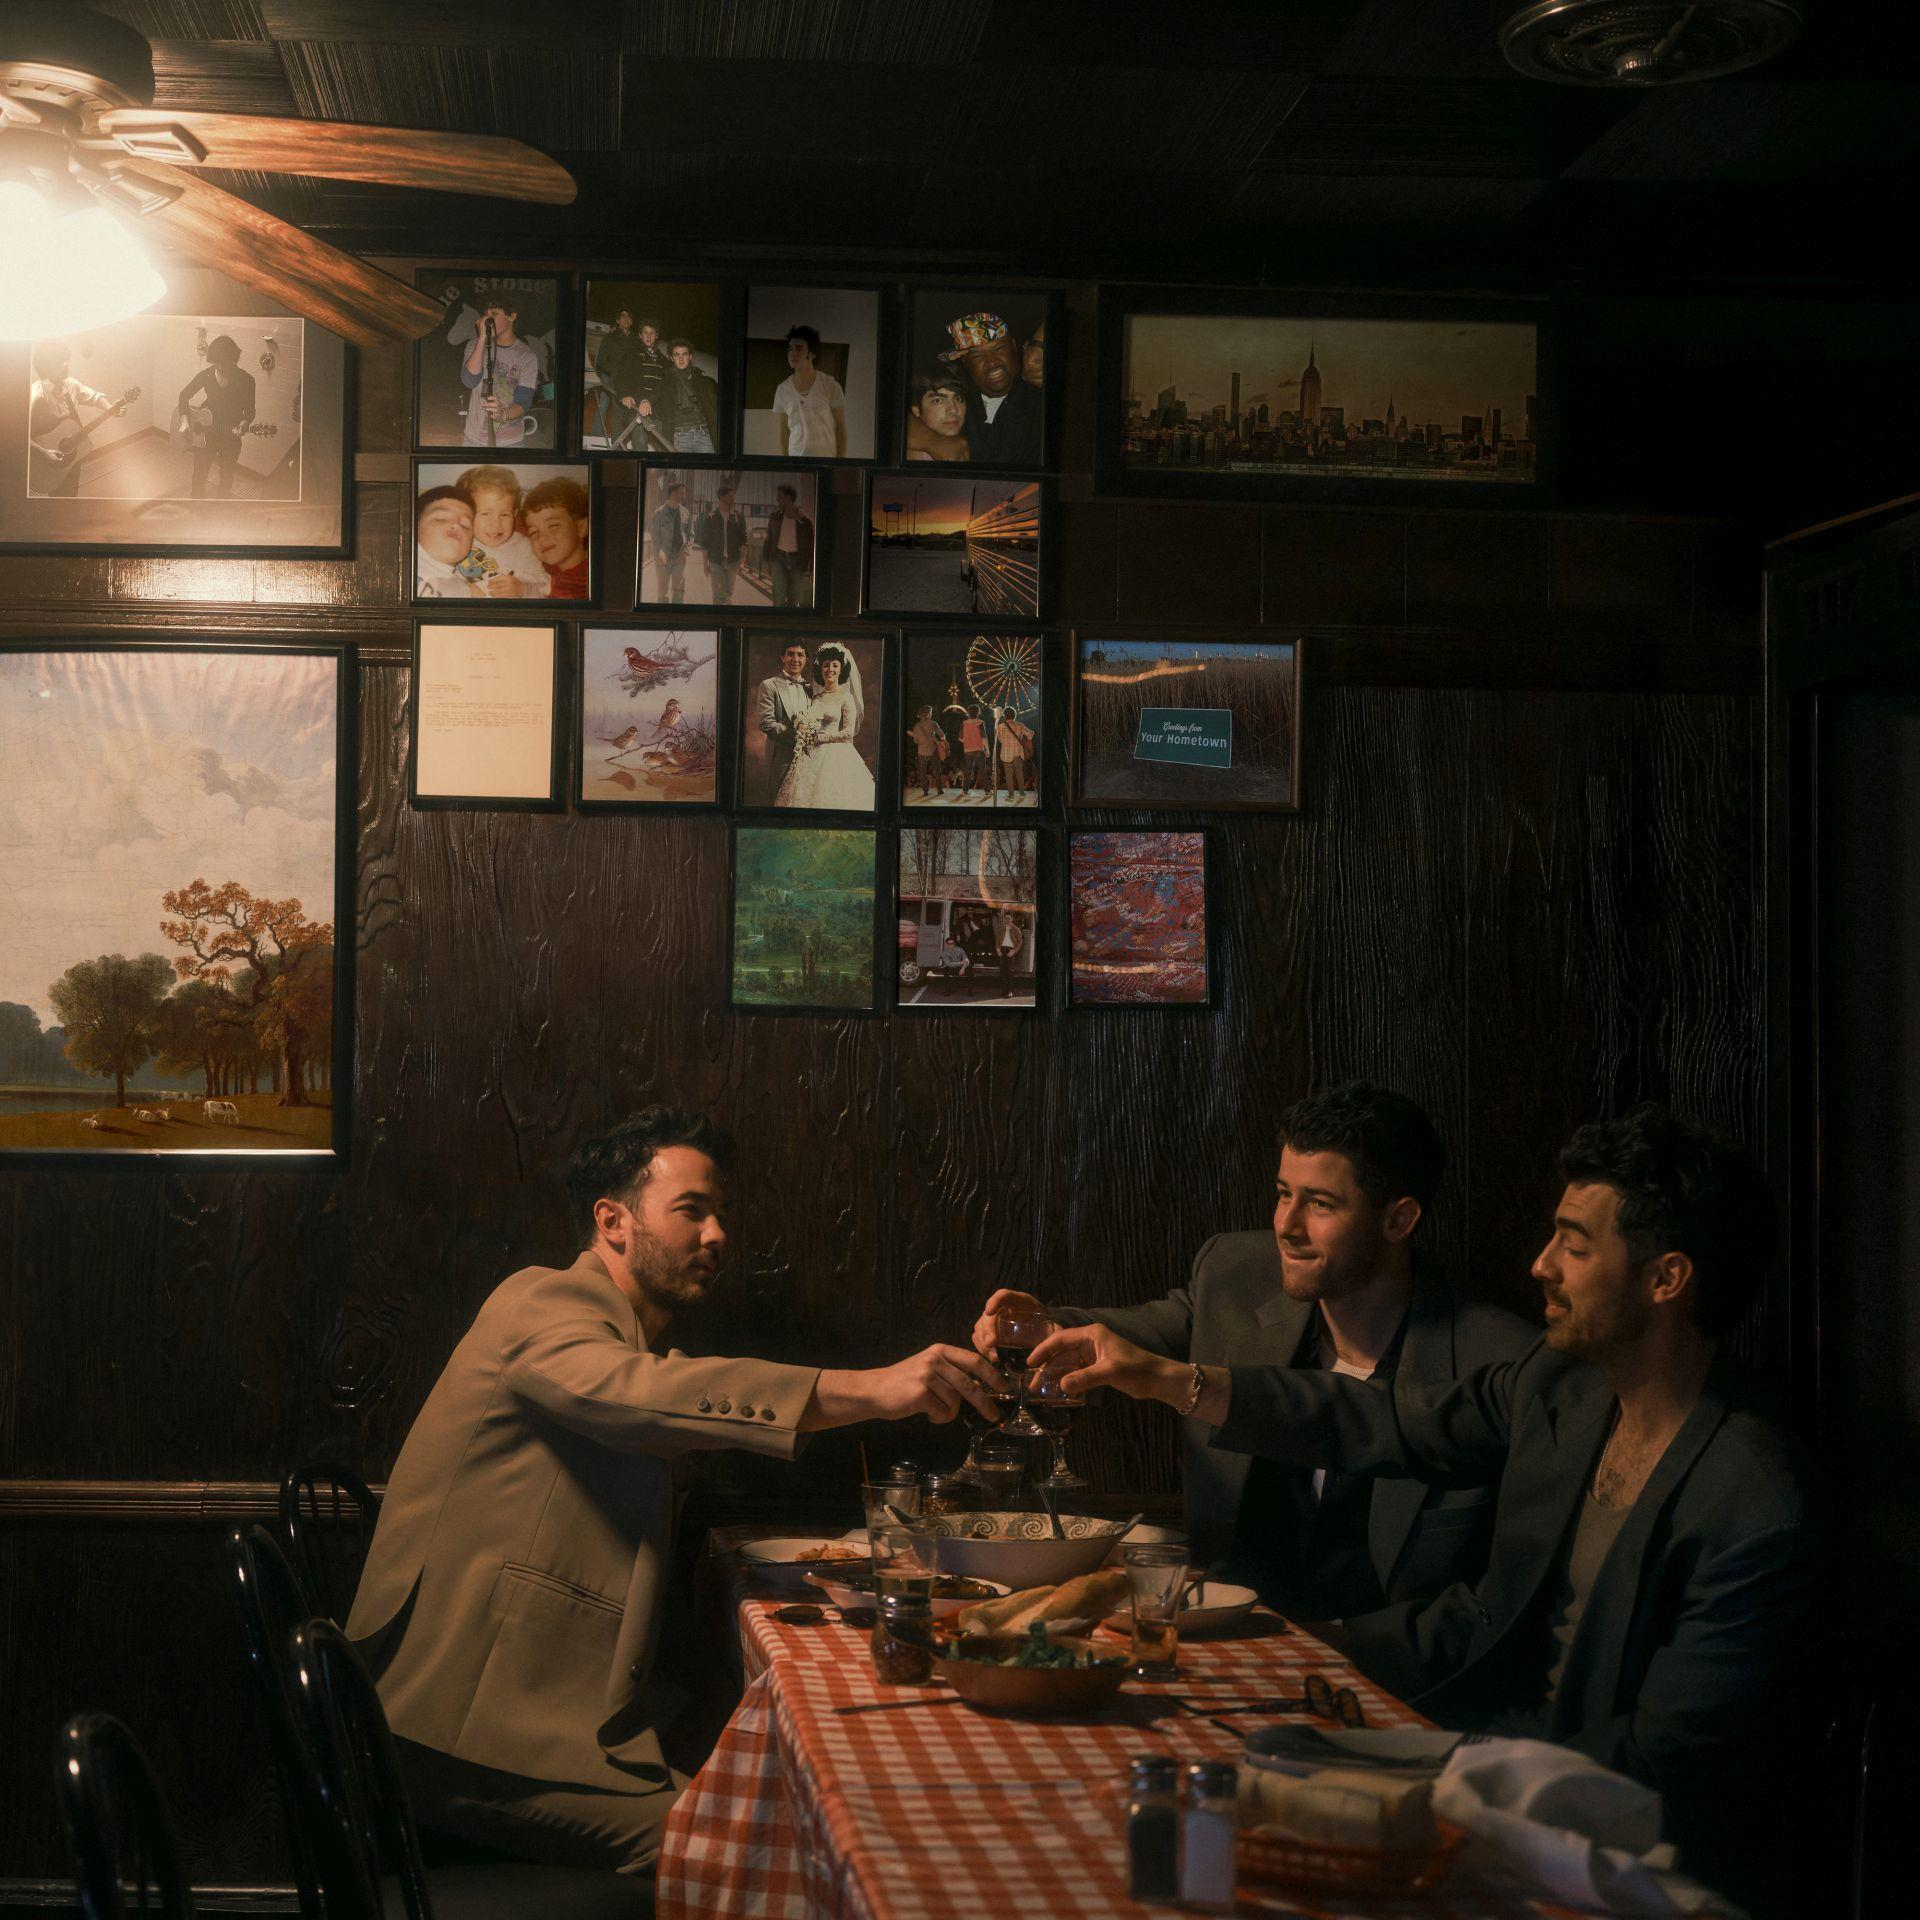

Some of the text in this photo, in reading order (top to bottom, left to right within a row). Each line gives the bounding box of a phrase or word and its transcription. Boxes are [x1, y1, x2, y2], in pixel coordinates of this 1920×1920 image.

[1188, 723, 1203, 733] from
[1141, 732, 1227, 748] Your Hometown
